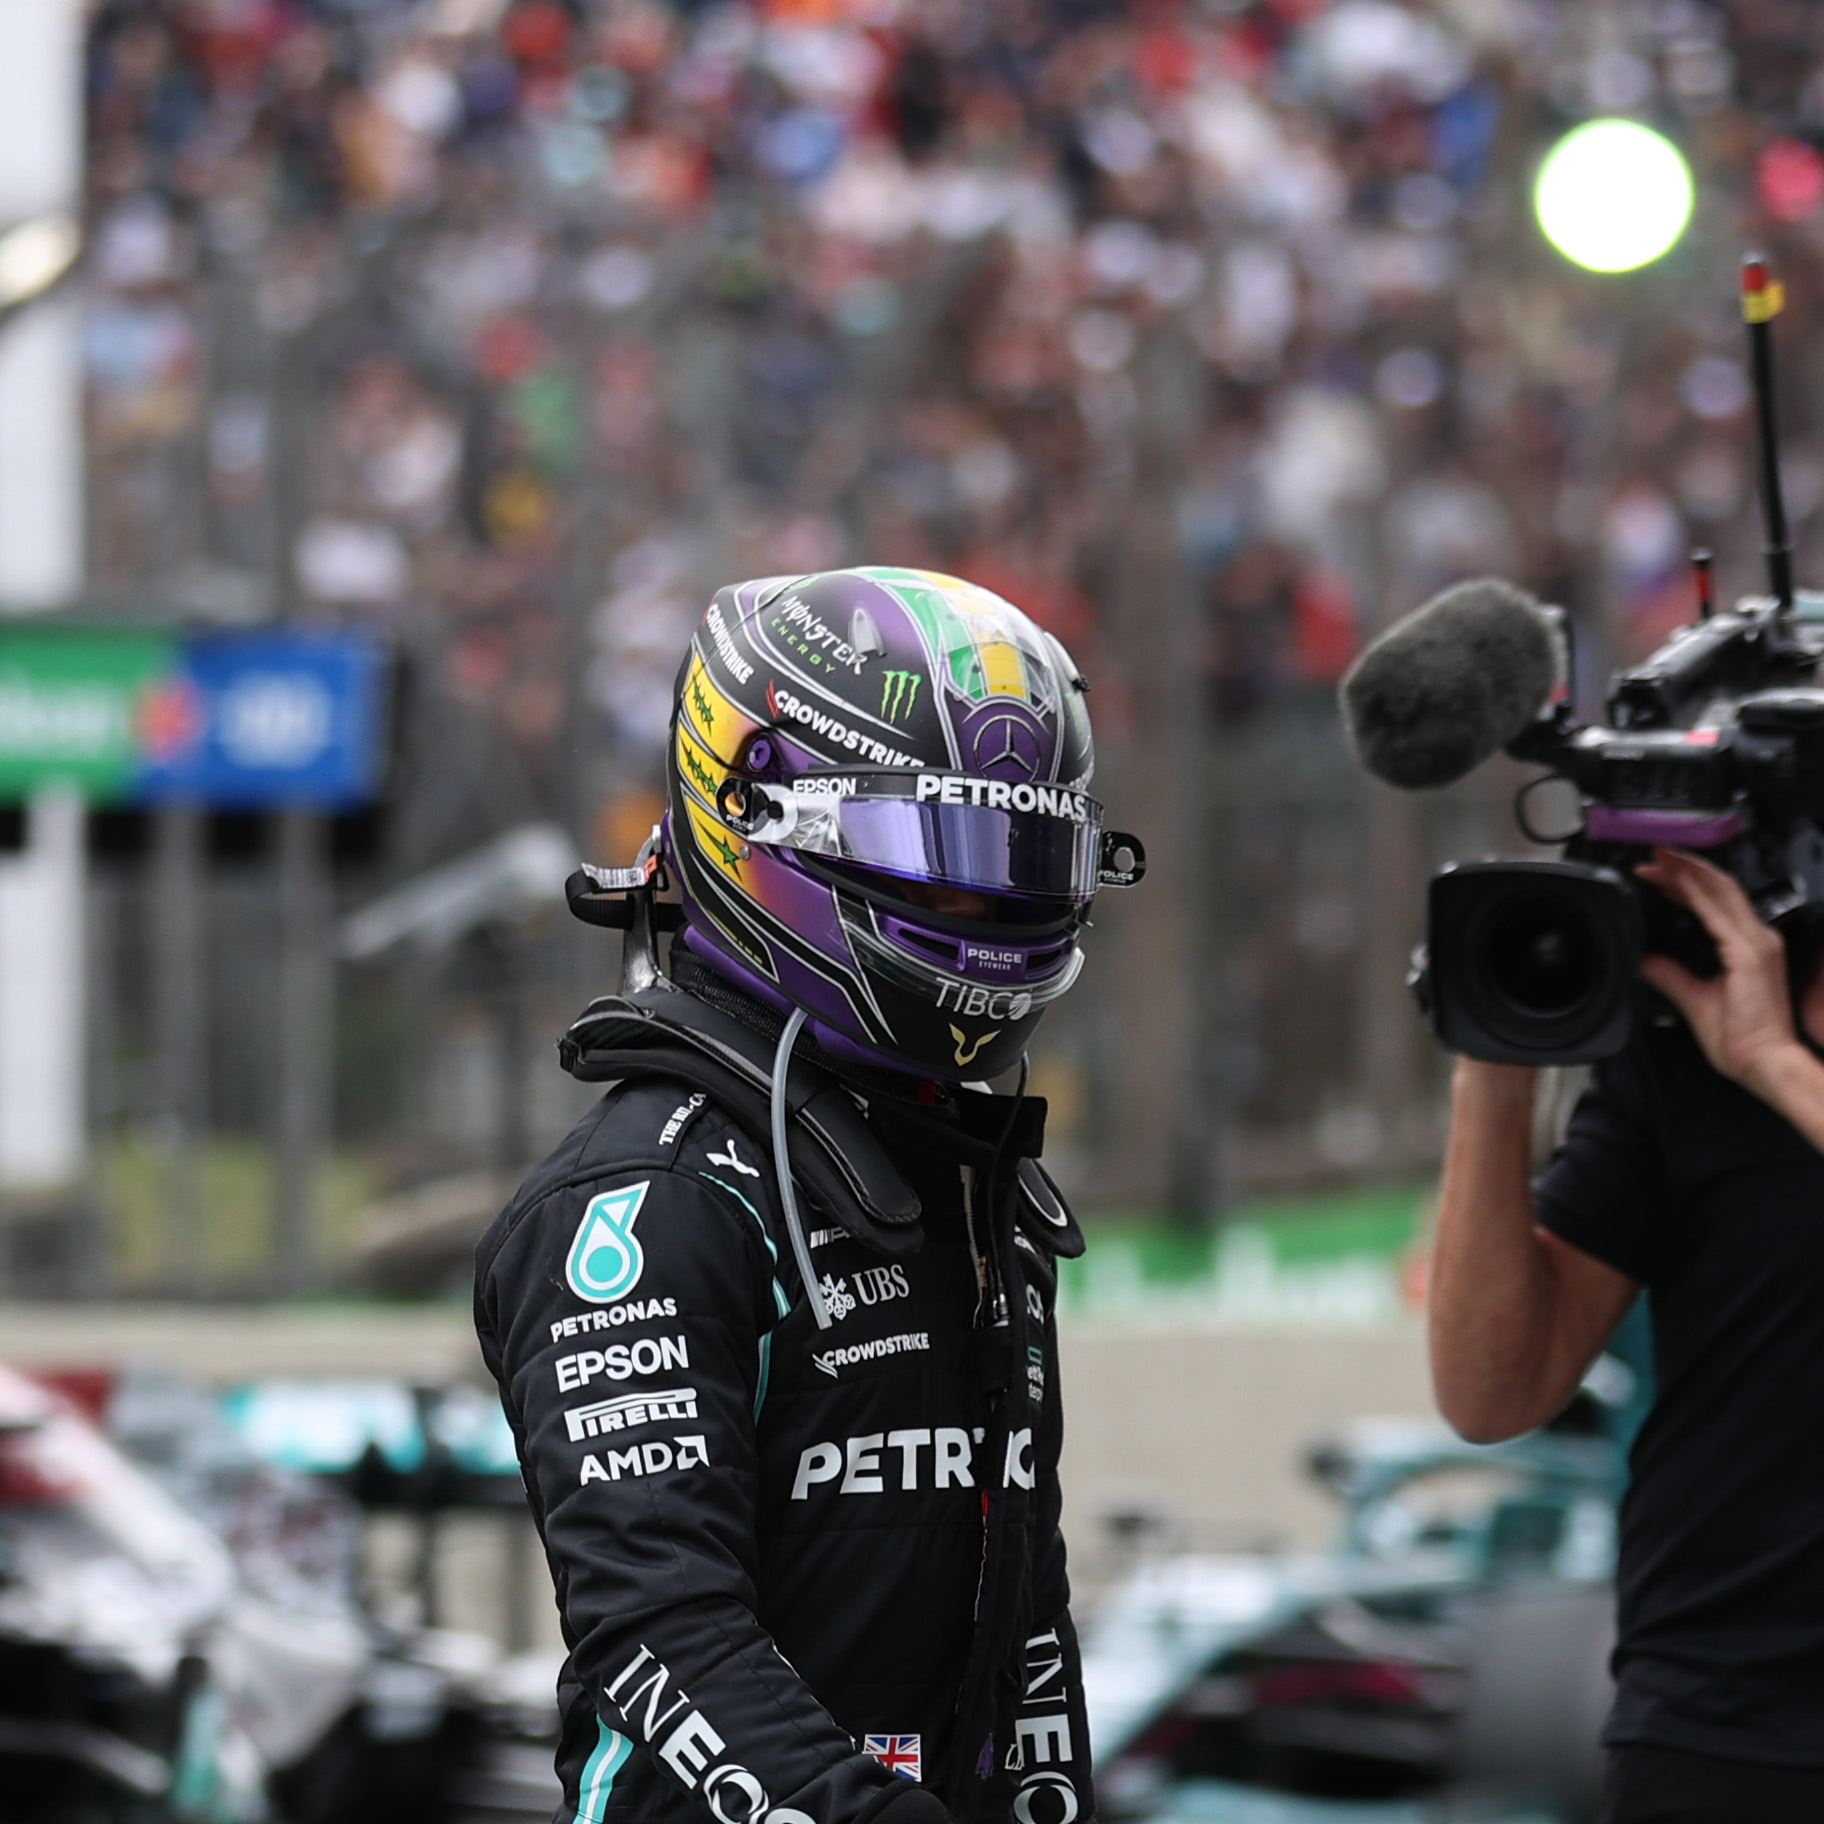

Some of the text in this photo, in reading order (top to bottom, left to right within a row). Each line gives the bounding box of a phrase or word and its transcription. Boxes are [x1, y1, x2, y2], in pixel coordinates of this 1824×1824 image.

[706, 604, 755, 686] CROWDSTRIKE
[770, 617, 836, 674] ENERGY
[793, 778, 857, 796] EPSON
[916, 774, 1087, 822] PETRONAS
[967, 948, 1022, 964] POLICE
[978, 962, 1011, 971] EYEWEAR
[852, 1263, 910, 1306] UBS
[550, 1297, 678, 1343] PETRONAS
[555, 1335, 689, 1393] EPSON
[820, 1333, 930, 1368] CROWDSTRIKE
[564, 1387, 698, 1442] PIRELLI
[580, 1442, 673, 1486] AMD
